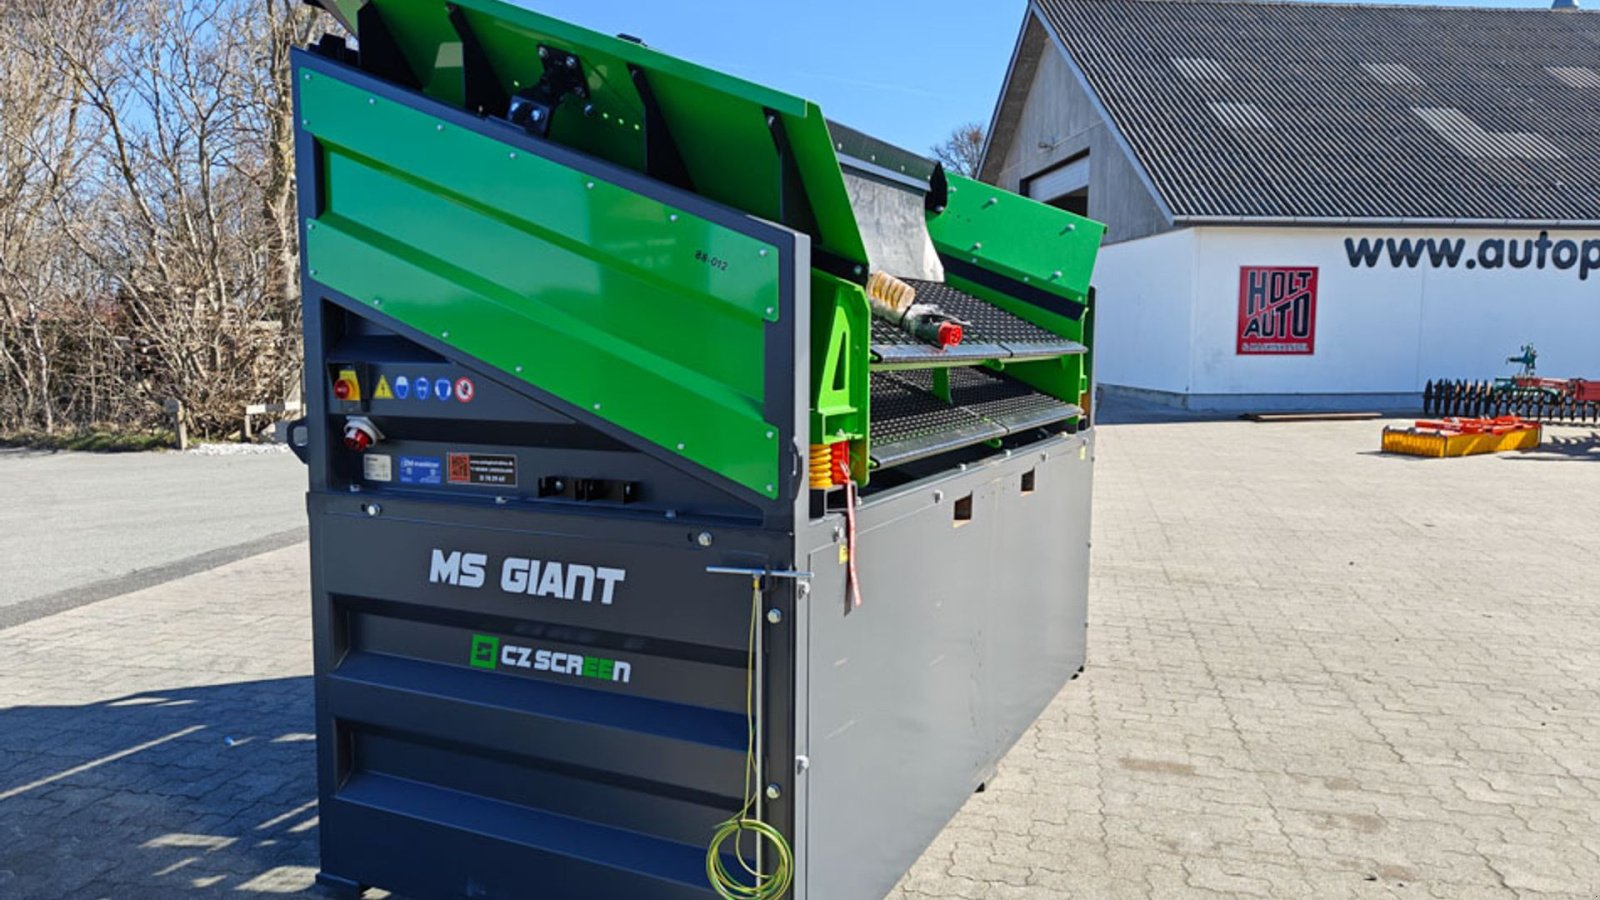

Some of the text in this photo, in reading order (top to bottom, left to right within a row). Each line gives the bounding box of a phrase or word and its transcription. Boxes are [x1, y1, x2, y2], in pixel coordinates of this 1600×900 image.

[1344, 230, 1600, 281] www.autop
[1242, 291, 1311, 338] AUTO
[1247, 270, 1312, 316] HOLT
[429, 548, 627, 605] MS GIANT
[501, 645, 631, 683] CZ SCREEN
